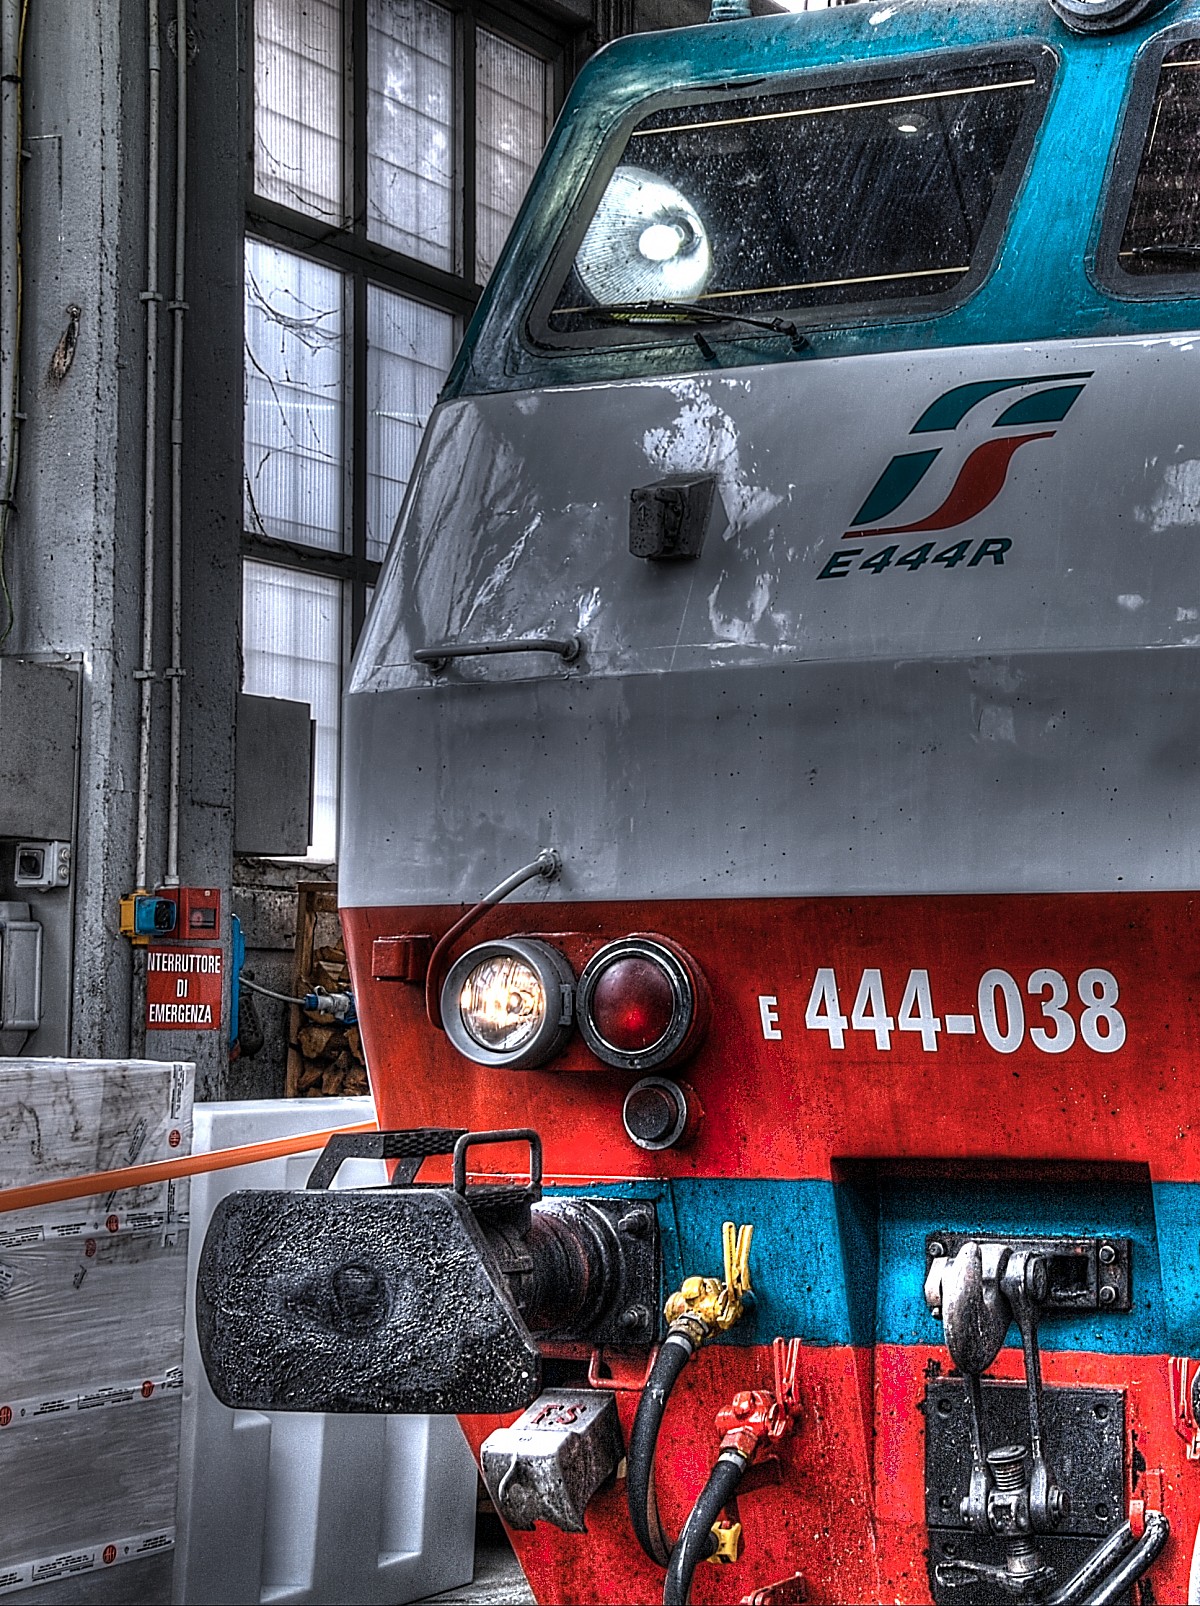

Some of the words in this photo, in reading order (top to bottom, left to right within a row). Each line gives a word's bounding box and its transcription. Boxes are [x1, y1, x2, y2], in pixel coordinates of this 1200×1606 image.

[816, 537, 1013, 581] E444R
[147, 952, 222, 974] NTERRUTTORE
[176, 978, 188, 998] DI
[149, 1003, 212, 1024] EMERGENZA
[758, 995, 782, 1040] E
[804, 967, 1127, 1054] 444-038
